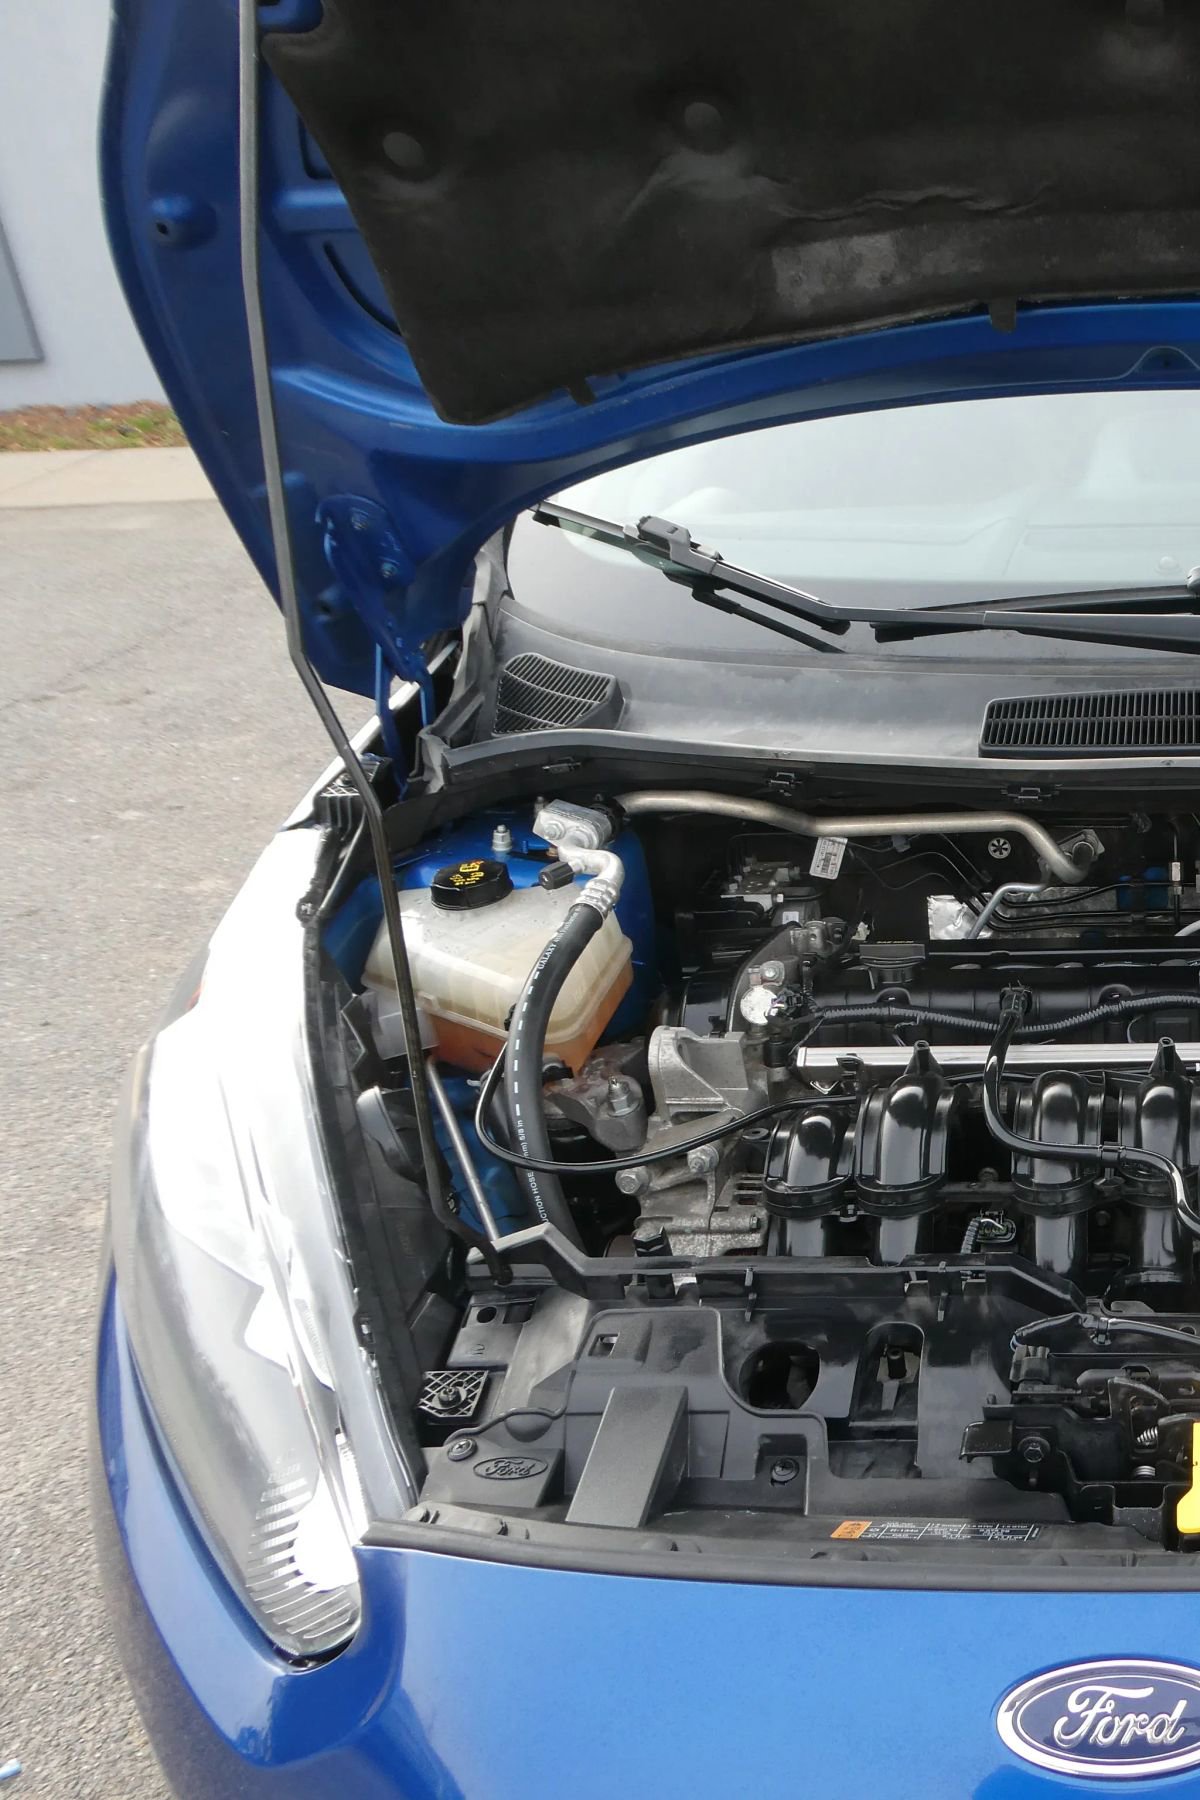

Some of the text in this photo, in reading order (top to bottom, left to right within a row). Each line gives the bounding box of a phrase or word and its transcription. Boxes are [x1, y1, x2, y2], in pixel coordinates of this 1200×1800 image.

[527, 1171, 539, 1195] HOSE
[534, 1195, 550, 1223] UCTION
[485, 1459, 537, 1476] Ford
[1053, 1685, 1188, 1749] Ford
